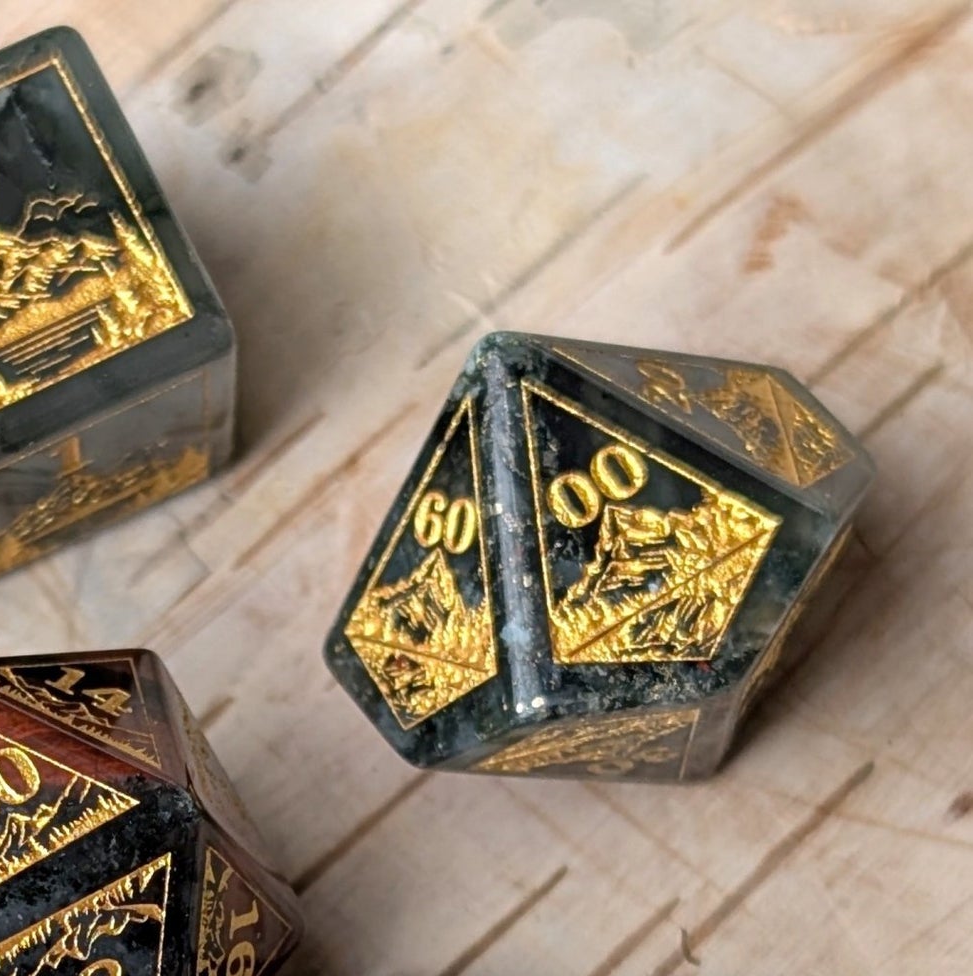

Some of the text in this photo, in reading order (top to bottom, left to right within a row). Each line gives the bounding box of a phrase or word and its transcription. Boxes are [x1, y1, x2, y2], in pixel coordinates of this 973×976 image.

[547, 443, 649, 528] 00
[414, 490, 478, 554] 60
[45, 666, 134, 717] 14
